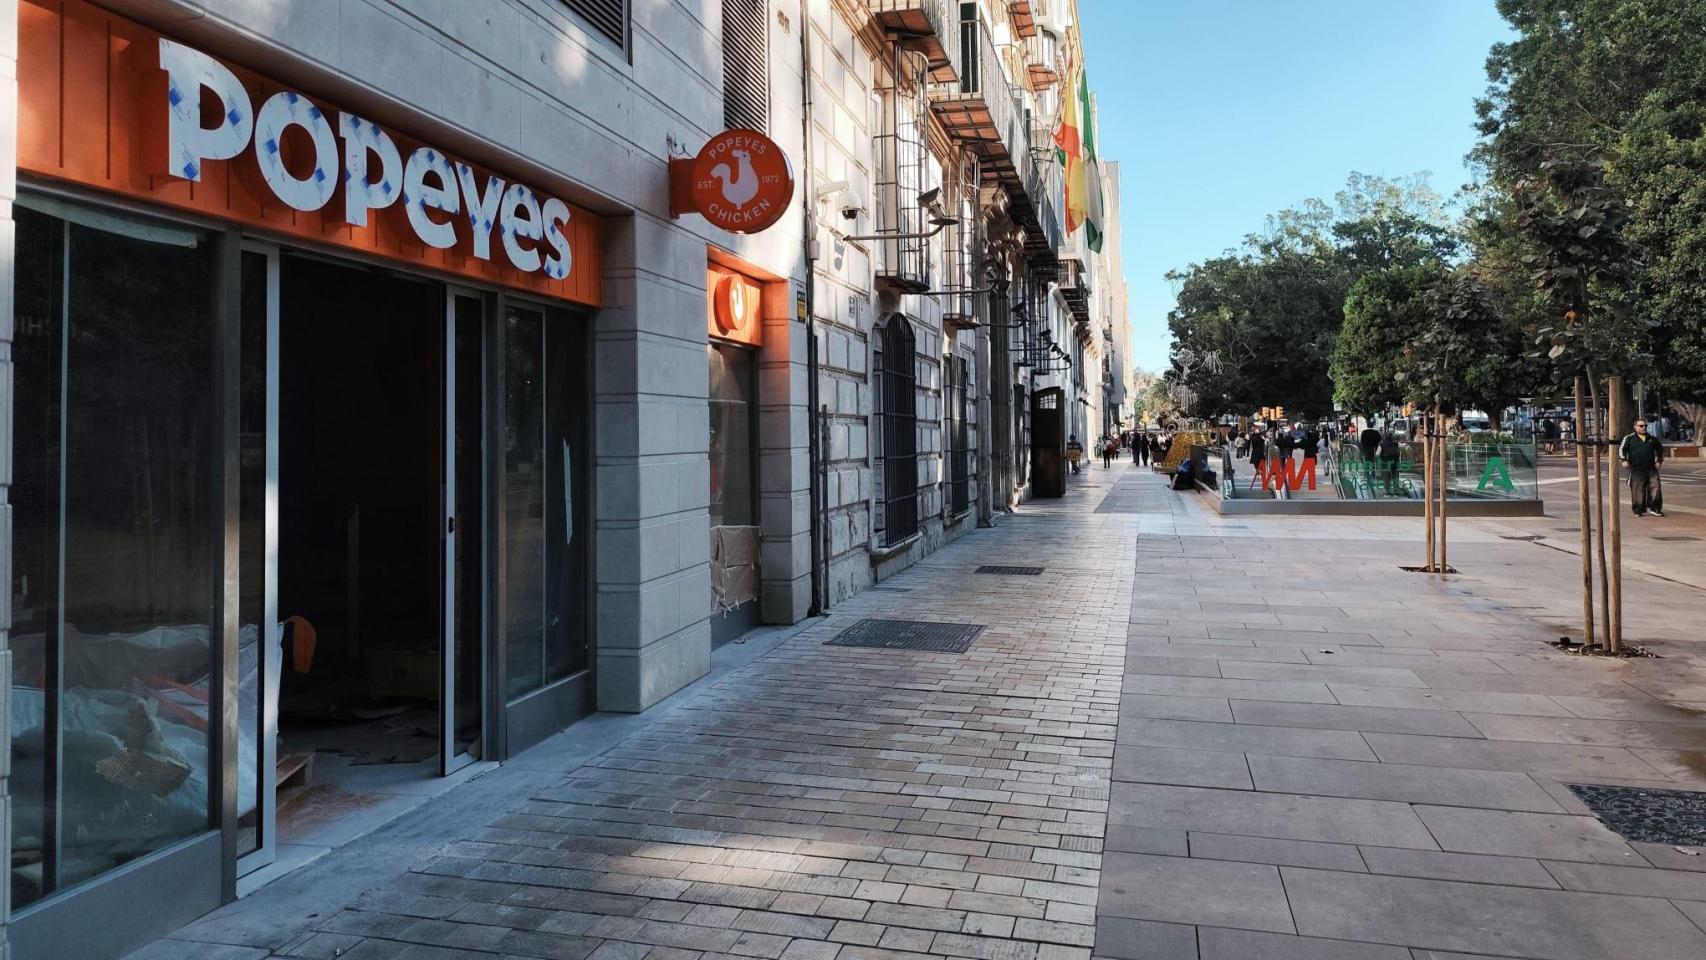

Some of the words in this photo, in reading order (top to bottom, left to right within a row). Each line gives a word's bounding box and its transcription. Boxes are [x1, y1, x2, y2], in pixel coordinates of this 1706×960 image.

[708, 136, 767, 159] POPEYES
[697, 180, 714, 190] EST.
[761, 175, 779, 184] 1972
[708, 198, 771, 223] CHICKEN
